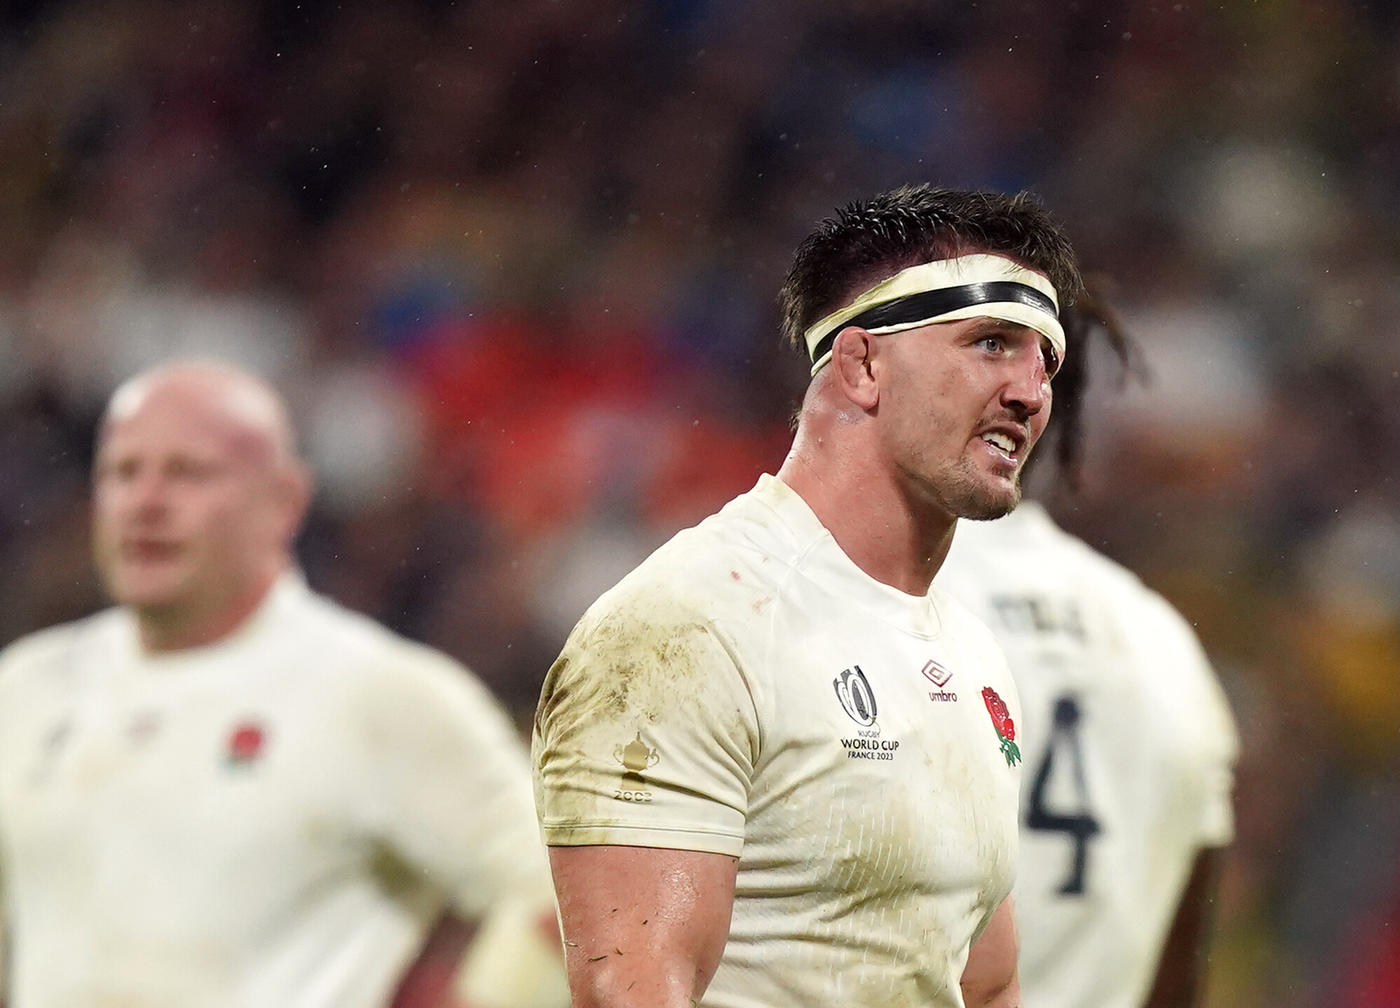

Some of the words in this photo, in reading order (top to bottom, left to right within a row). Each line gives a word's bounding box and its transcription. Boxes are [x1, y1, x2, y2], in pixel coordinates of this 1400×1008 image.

[929, 690, 957, 702] umbro
[841, 738, 879, 751] WORLD
[881, 740, 900, 751] CUP
[847, 751, 876, 760] FRANCE
[877, 752, 894, 761] 2023
